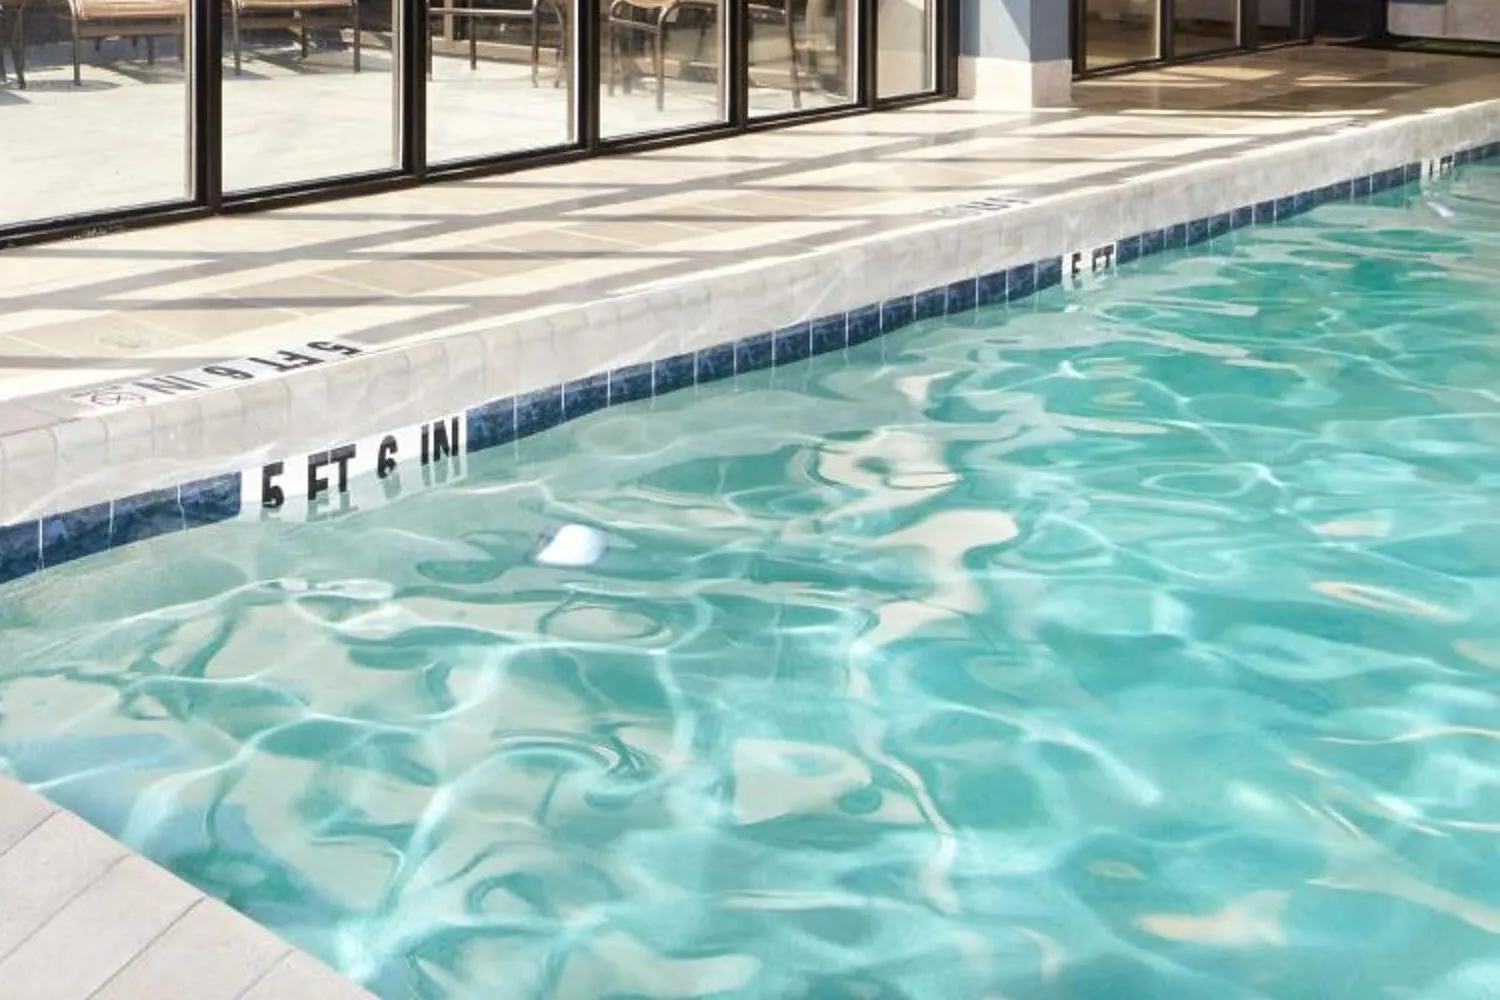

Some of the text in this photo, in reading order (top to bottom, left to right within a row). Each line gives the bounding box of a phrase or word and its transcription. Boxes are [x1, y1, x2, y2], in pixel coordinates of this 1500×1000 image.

[307, 341, 362, 356] 5
[248, 350, 325, 371] FT
[203, 365, 255, 380] 6
[132, 375, 212, 395] IN
[262, 416, 460, 509] 5 FT 6 IN
